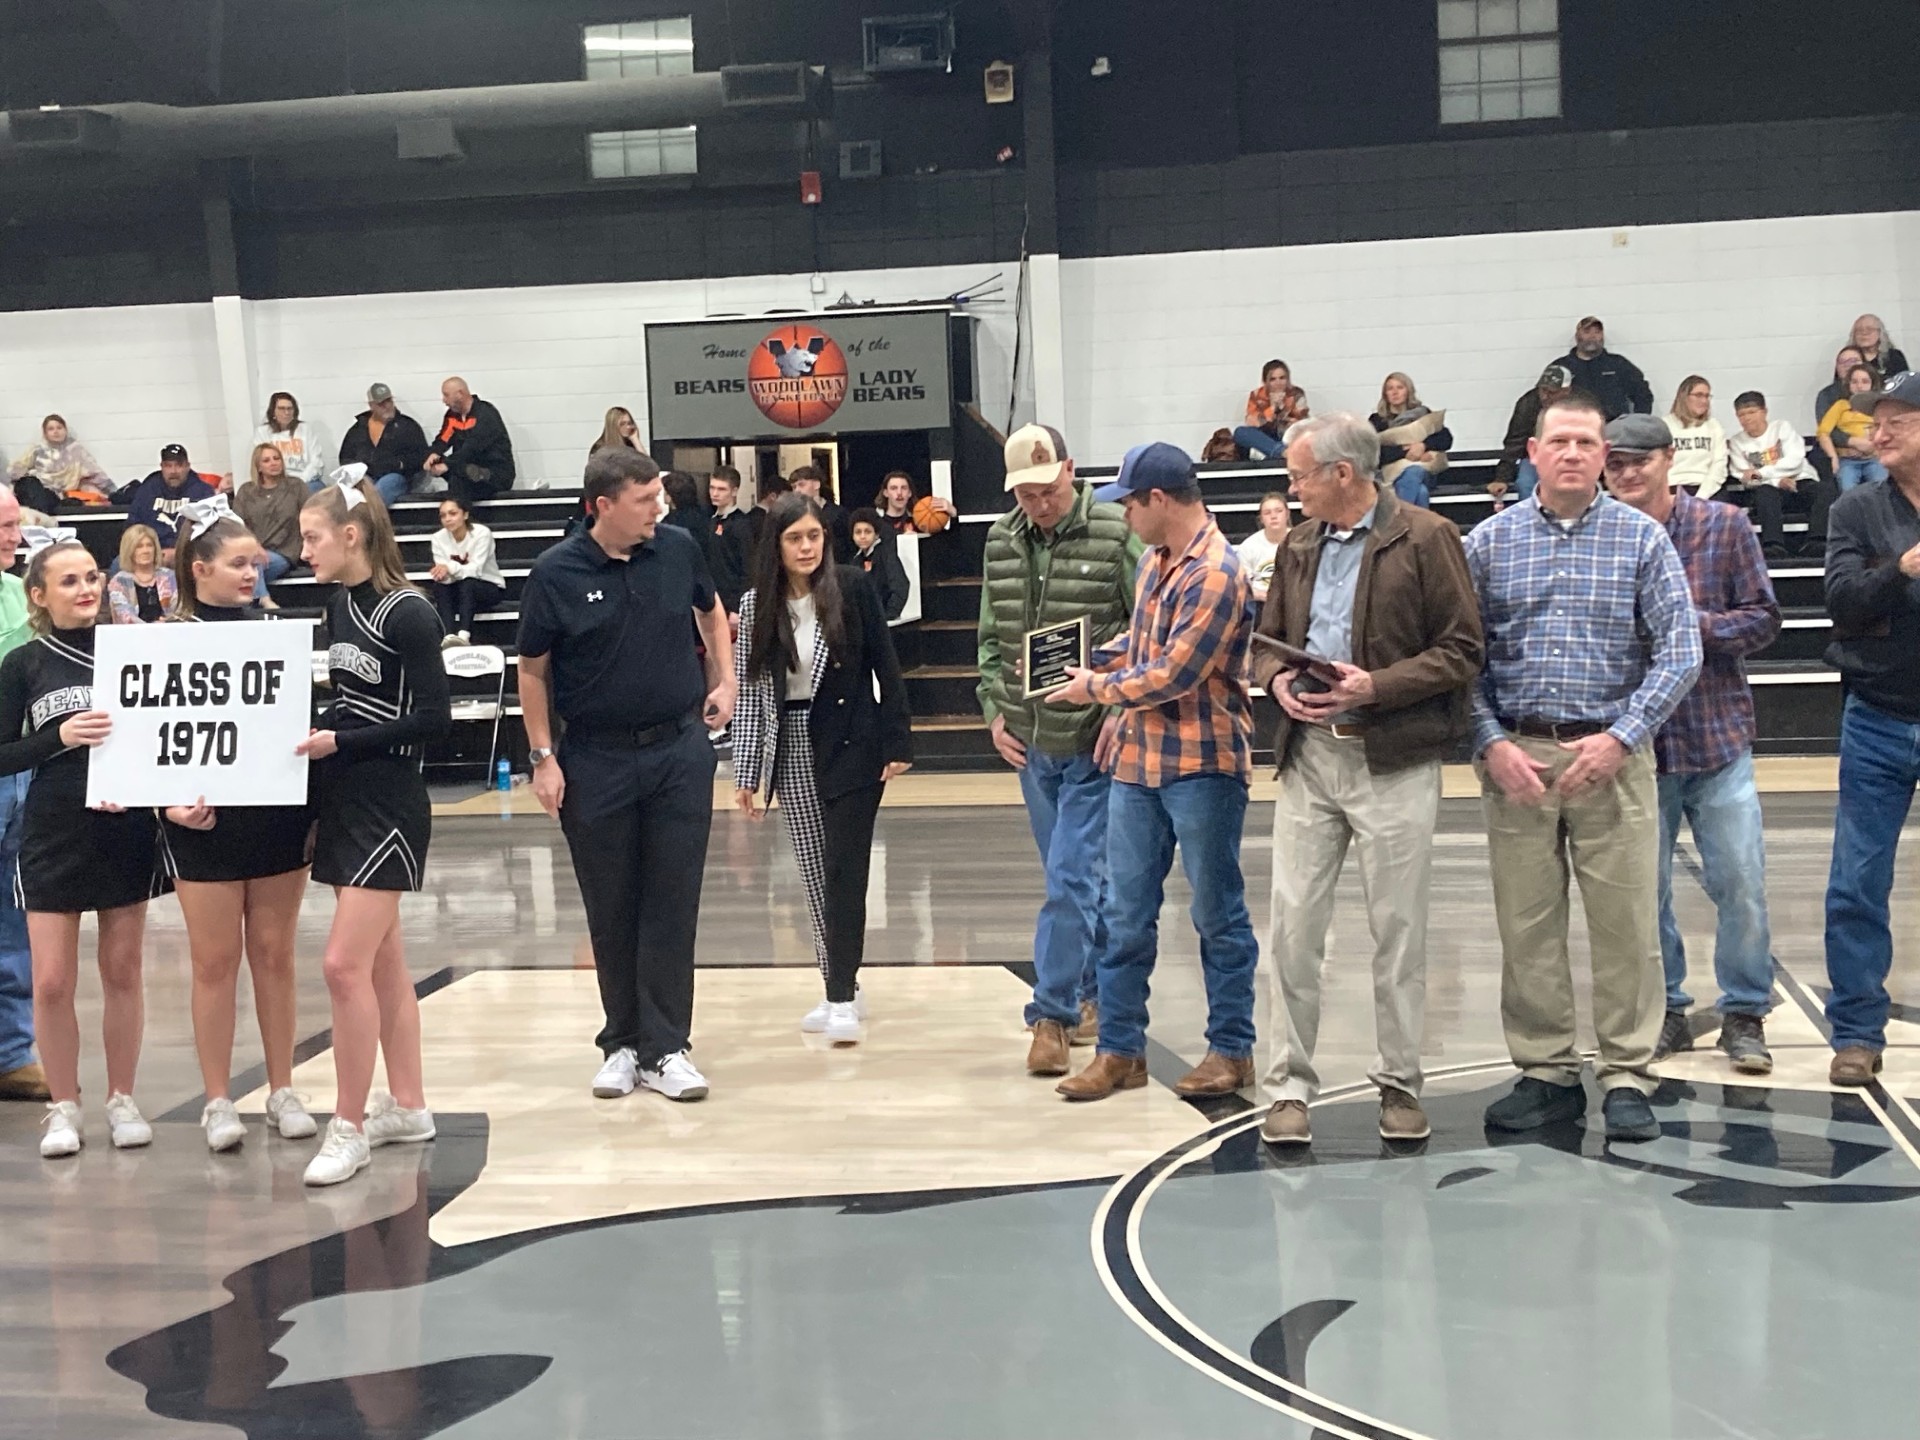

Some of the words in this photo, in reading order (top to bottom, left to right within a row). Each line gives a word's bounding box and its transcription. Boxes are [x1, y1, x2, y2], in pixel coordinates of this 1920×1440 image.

[702, 343, 747, 360] Home
[847, 339, 864, 357] of
[868, 336, 891, 352] the
[859, 368, 918, 386] LADY
[674, 378, 746, 396] BEARS
[752, 378, 845, 395] WOODLAWN
[853, 385, 926, 403] BEARS
[1673, 438, 1693, 451] AME
[1695, 437, 1712, 451] DAY
[120, 662, 231, 708] CLASS
[241, 660, 284, 705] OF
[157, 721, 238, 766] 1970
